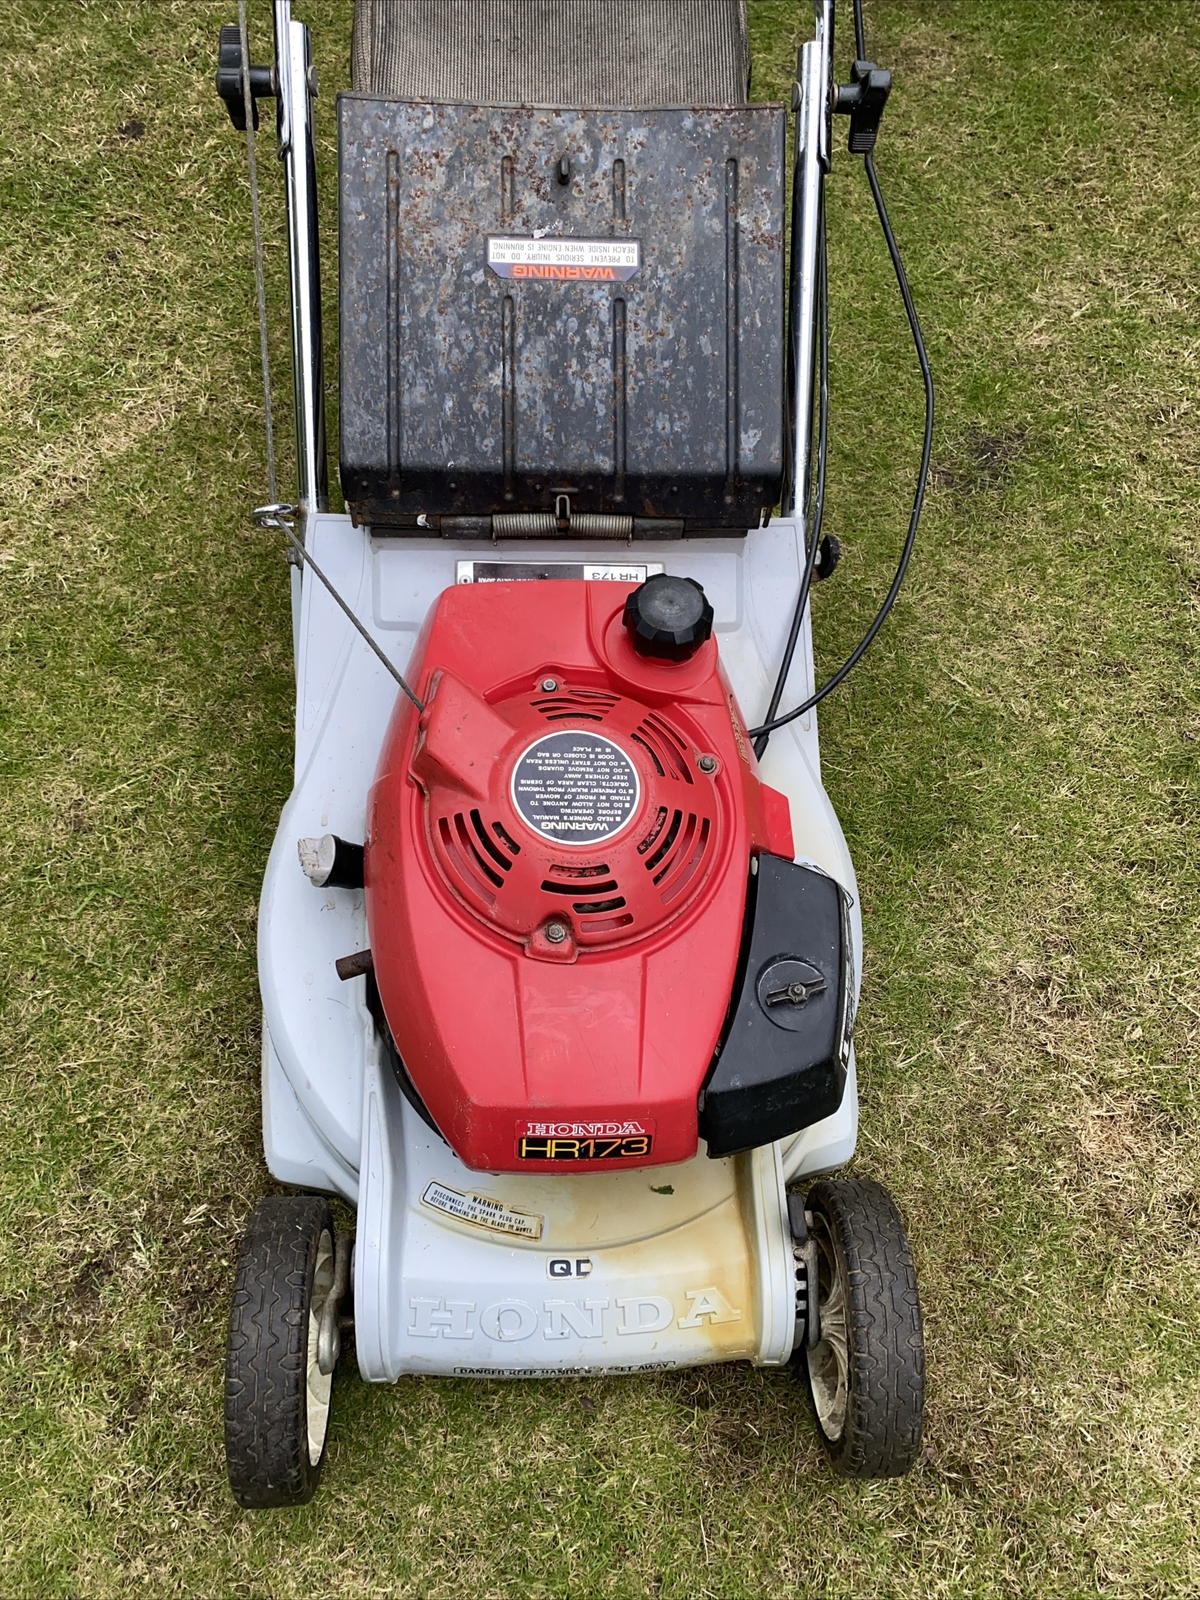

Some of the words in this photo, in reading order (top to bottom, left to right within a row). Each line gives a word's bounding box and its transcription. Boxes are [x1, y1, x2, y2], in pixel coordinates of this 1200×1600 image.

[556, 254, 584, 262] SERIOUS
[512, 265, 615, 279] WARNING
[592, 572, 616, 580] 173
[541, 822, 609, 830] WARNING
[527, 1122, 645, 1136] HONDA
[522, 1137, 648, 1158] HR173
[433, 1190, 464, 1208] DISCONNECT
[467, 1205, 477, 1213] THE
[479, 1209, 496, 1219] SPARK
[499, 1215, 512, 1223] PLUG
[472, 1196, 503, 1212] WARNING
[430, 1196, 448, 1208] BEFORE
[480, 1216, 488, 1225] THE
[491, 1220, 506, 1229] BLADE
[407, 1287, 742, 1342] HONDA
